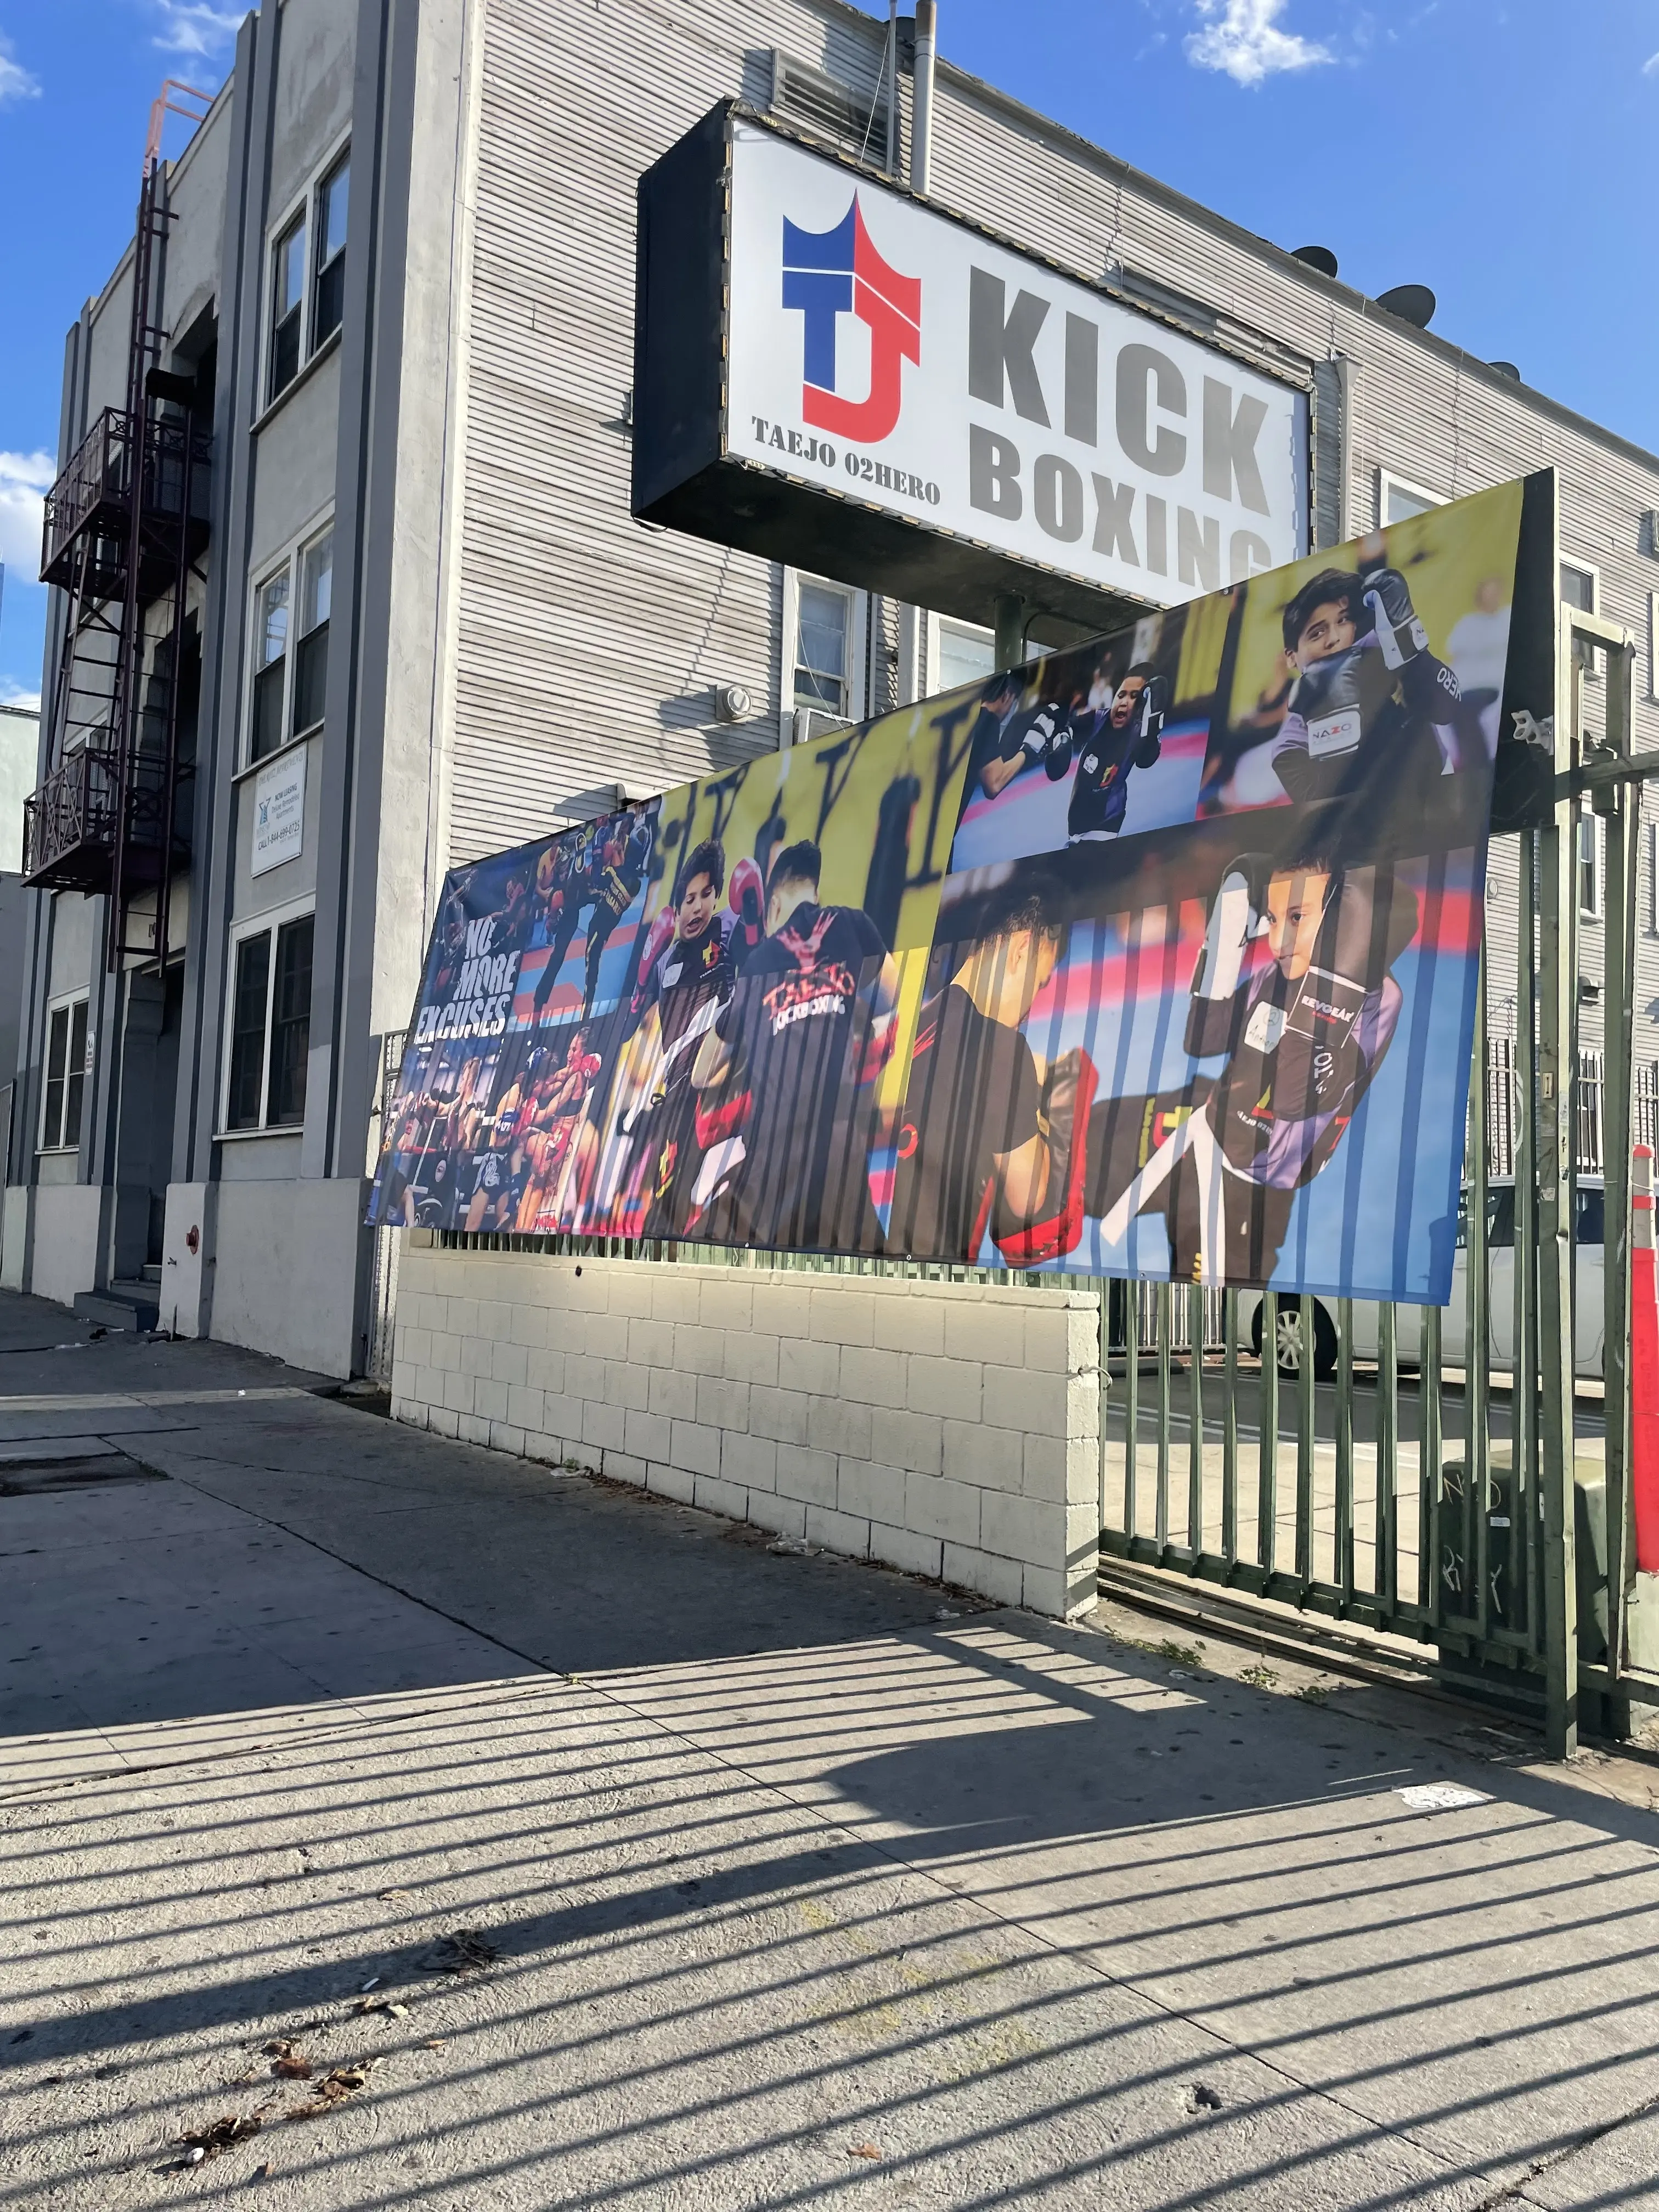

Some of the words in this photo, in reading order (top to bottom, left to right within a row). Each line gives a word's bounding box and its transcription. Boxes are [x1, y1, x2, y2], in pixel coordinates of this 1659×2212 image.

[969, 264, 1271, 517] KICK
[752, 416, 836, 467] TAEJO
[845, 453, 940, 505] 02HERO
[969, 422, 1272, 592] BOXING
[258, 840, 267, 850] CALL
[465, 916, 497, 959] NO
[453, 950, 521, 1001] MORE
[413, 993, 511, 1045] EXCUSES
